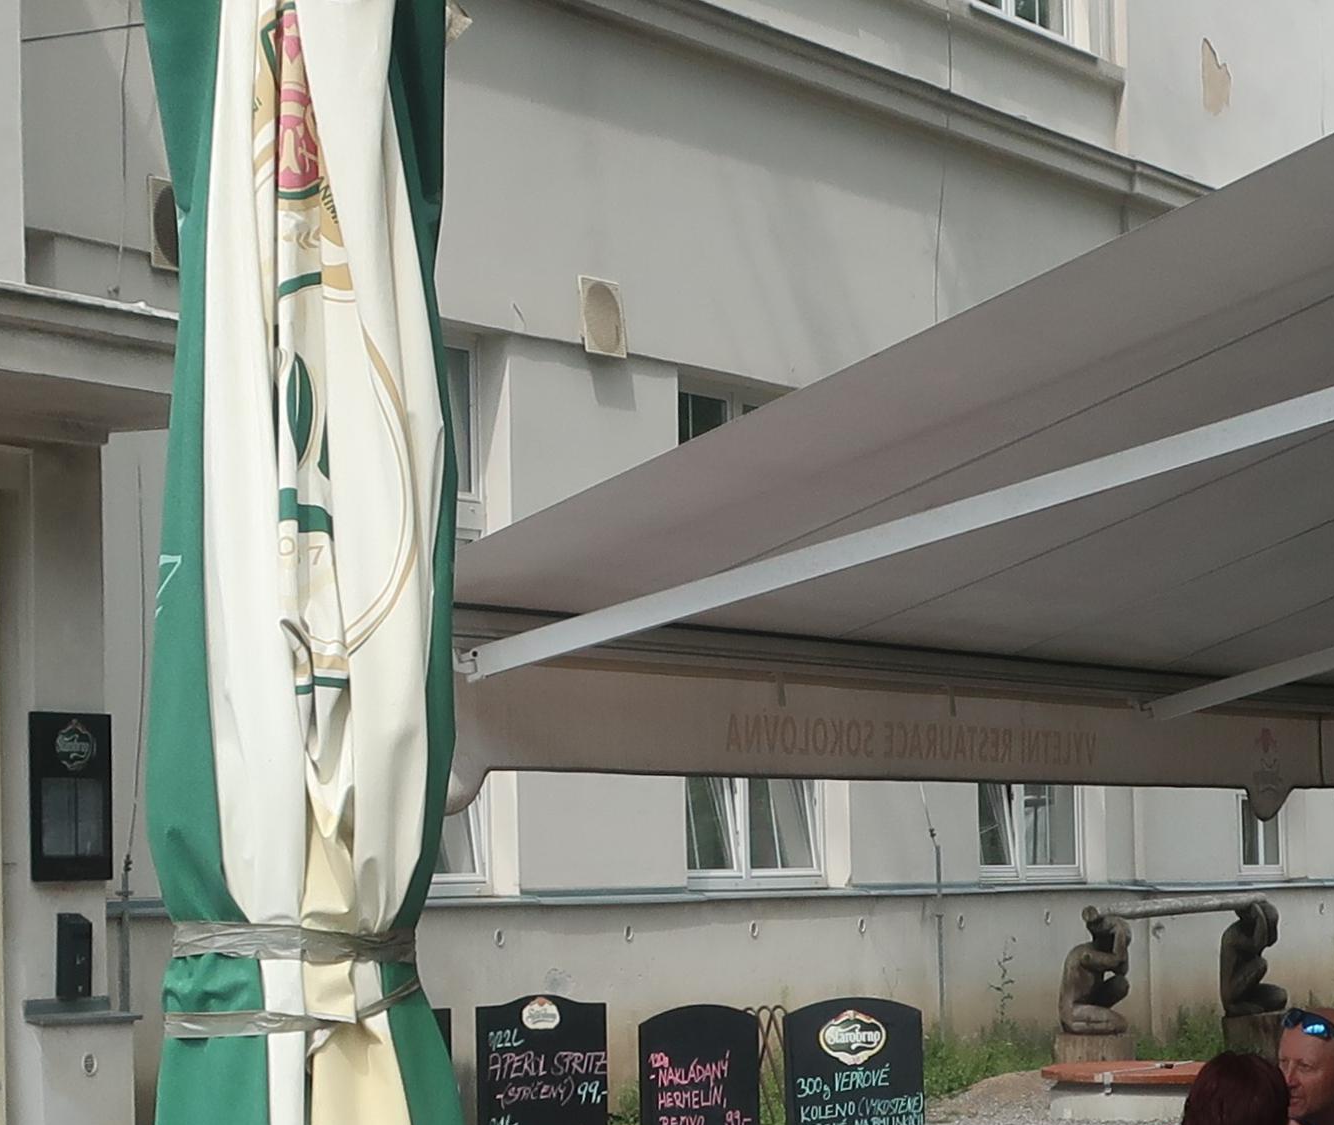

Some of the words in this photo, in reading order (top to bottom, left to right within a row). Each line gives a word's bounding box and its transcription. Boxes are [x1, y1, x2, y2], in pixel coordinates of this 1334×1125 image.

[826, 1023, 881, 1050] Starobrno
[488, 1051, 547, 1081] APEROL
[834, 1064, 890, 1092] VEPŘOVÉ
[800, 1100, 855, 1122] KOLENO
